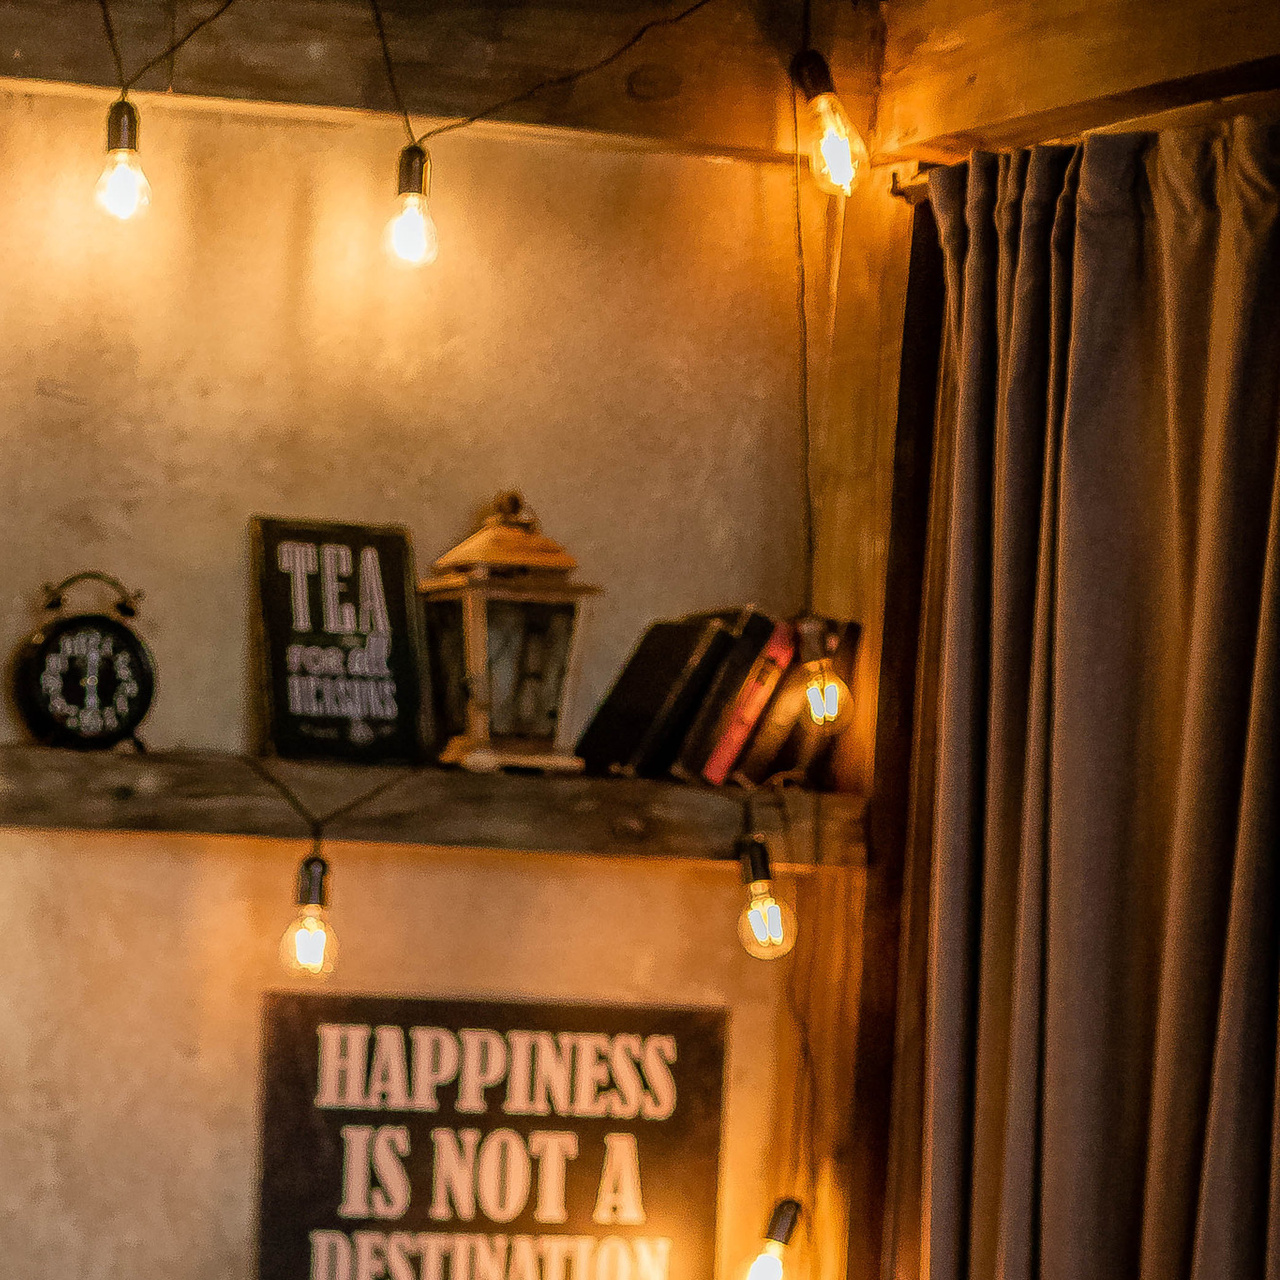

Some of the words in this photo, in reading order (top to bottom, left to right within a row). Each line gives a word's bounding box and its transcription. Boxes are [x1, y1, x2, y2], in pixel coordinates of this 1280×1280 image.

[276, 541, 392, 634] TEA
[314, 1023, 677, 1121] HAPPINESS
[337, 1125, 411, 1219] IS
[428, 1127, 579, 1224] NOT
[592, 1132, 647, 1225] A
